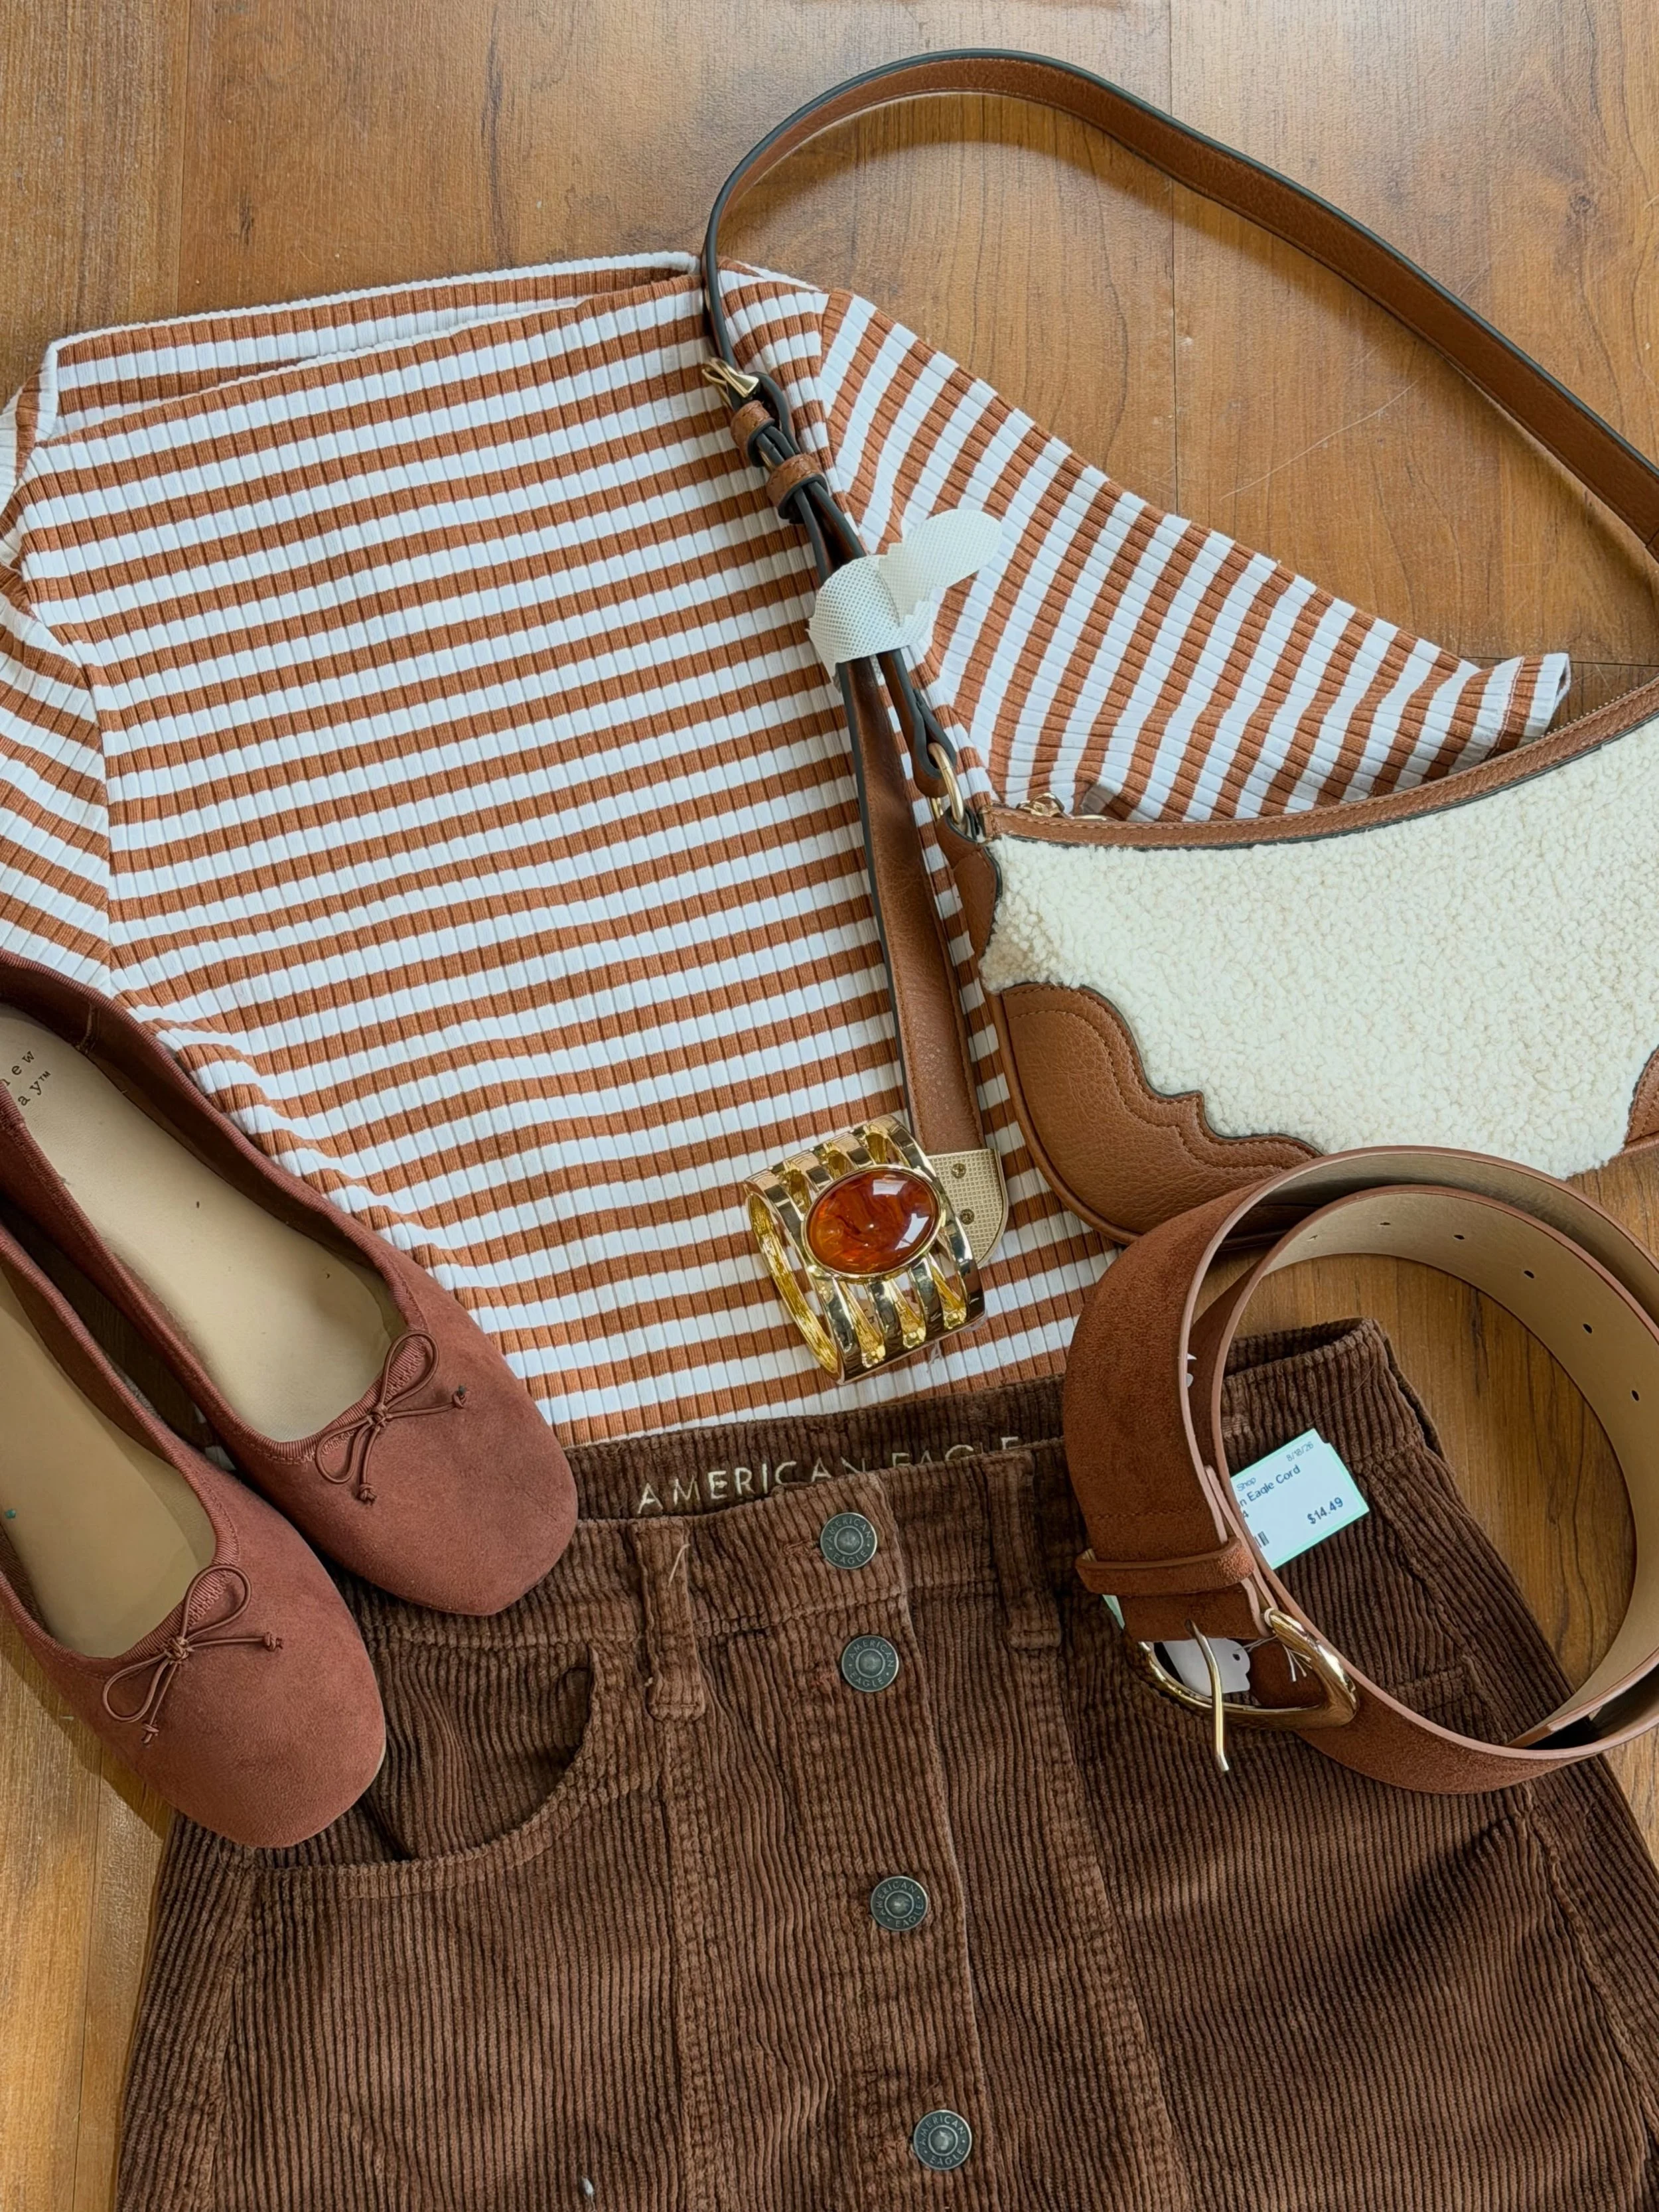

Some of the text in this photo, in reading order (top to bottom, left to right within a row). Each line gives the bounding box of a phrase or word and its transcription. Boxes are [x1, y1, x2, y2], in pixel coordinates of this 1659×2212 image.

[1236, 1477, 1256, 1492] Shop
[1246, 1482, 1275, 1502] Eagle
[1275, 1464, 1301, 1484] Cord
[1307, 1497, 1344, 1524] $14.49
[826, 1517, 873, 1564] AMERICAN EAGLE
[848, 1639, 895, 1687] AMERICAN EAGLE
[875, 1880, 924, 1928] AMERICAN EAGLE
[920, 2115, 966, 2166] AMERICAN EAGLE
